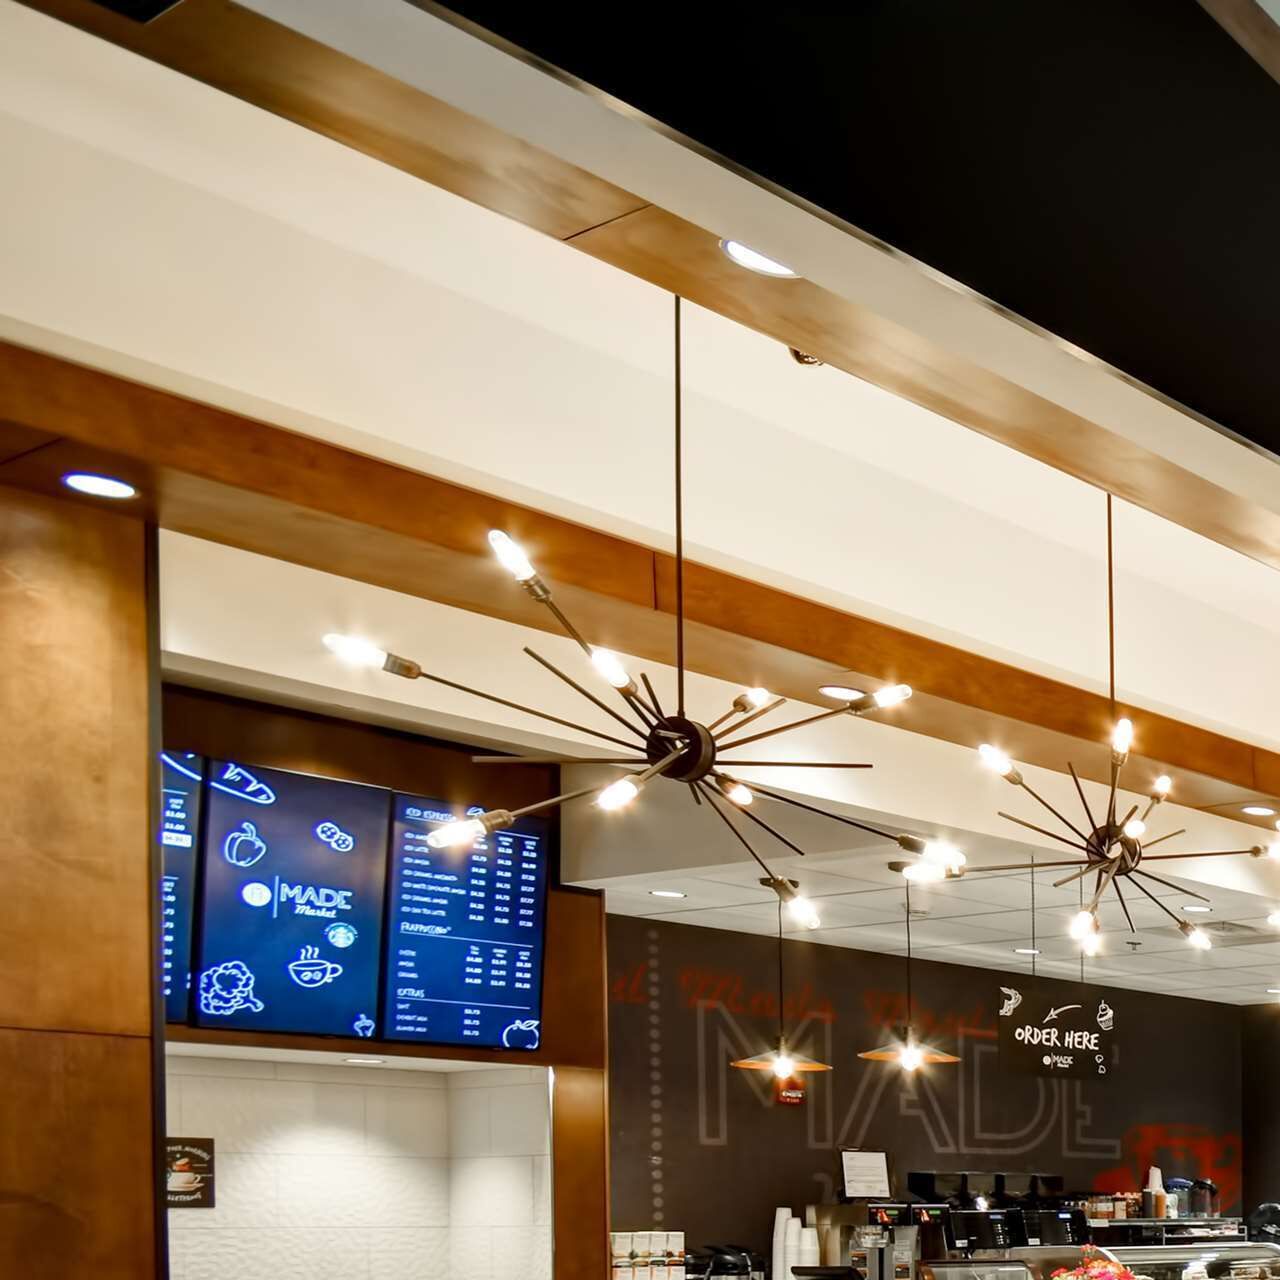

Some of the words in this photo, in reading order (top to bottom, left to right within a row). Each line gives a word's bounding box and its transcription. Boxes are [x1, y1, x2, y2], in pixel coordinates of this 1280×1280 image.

[280, 883, 352, 910] MADE
[294, 904, 337, 918] Market
[1015, 1025, 1061, 1047] ORDER
[1064, 1030, 1099, 1051] HERE
[699, 1001, 1121, 1161] MADE
